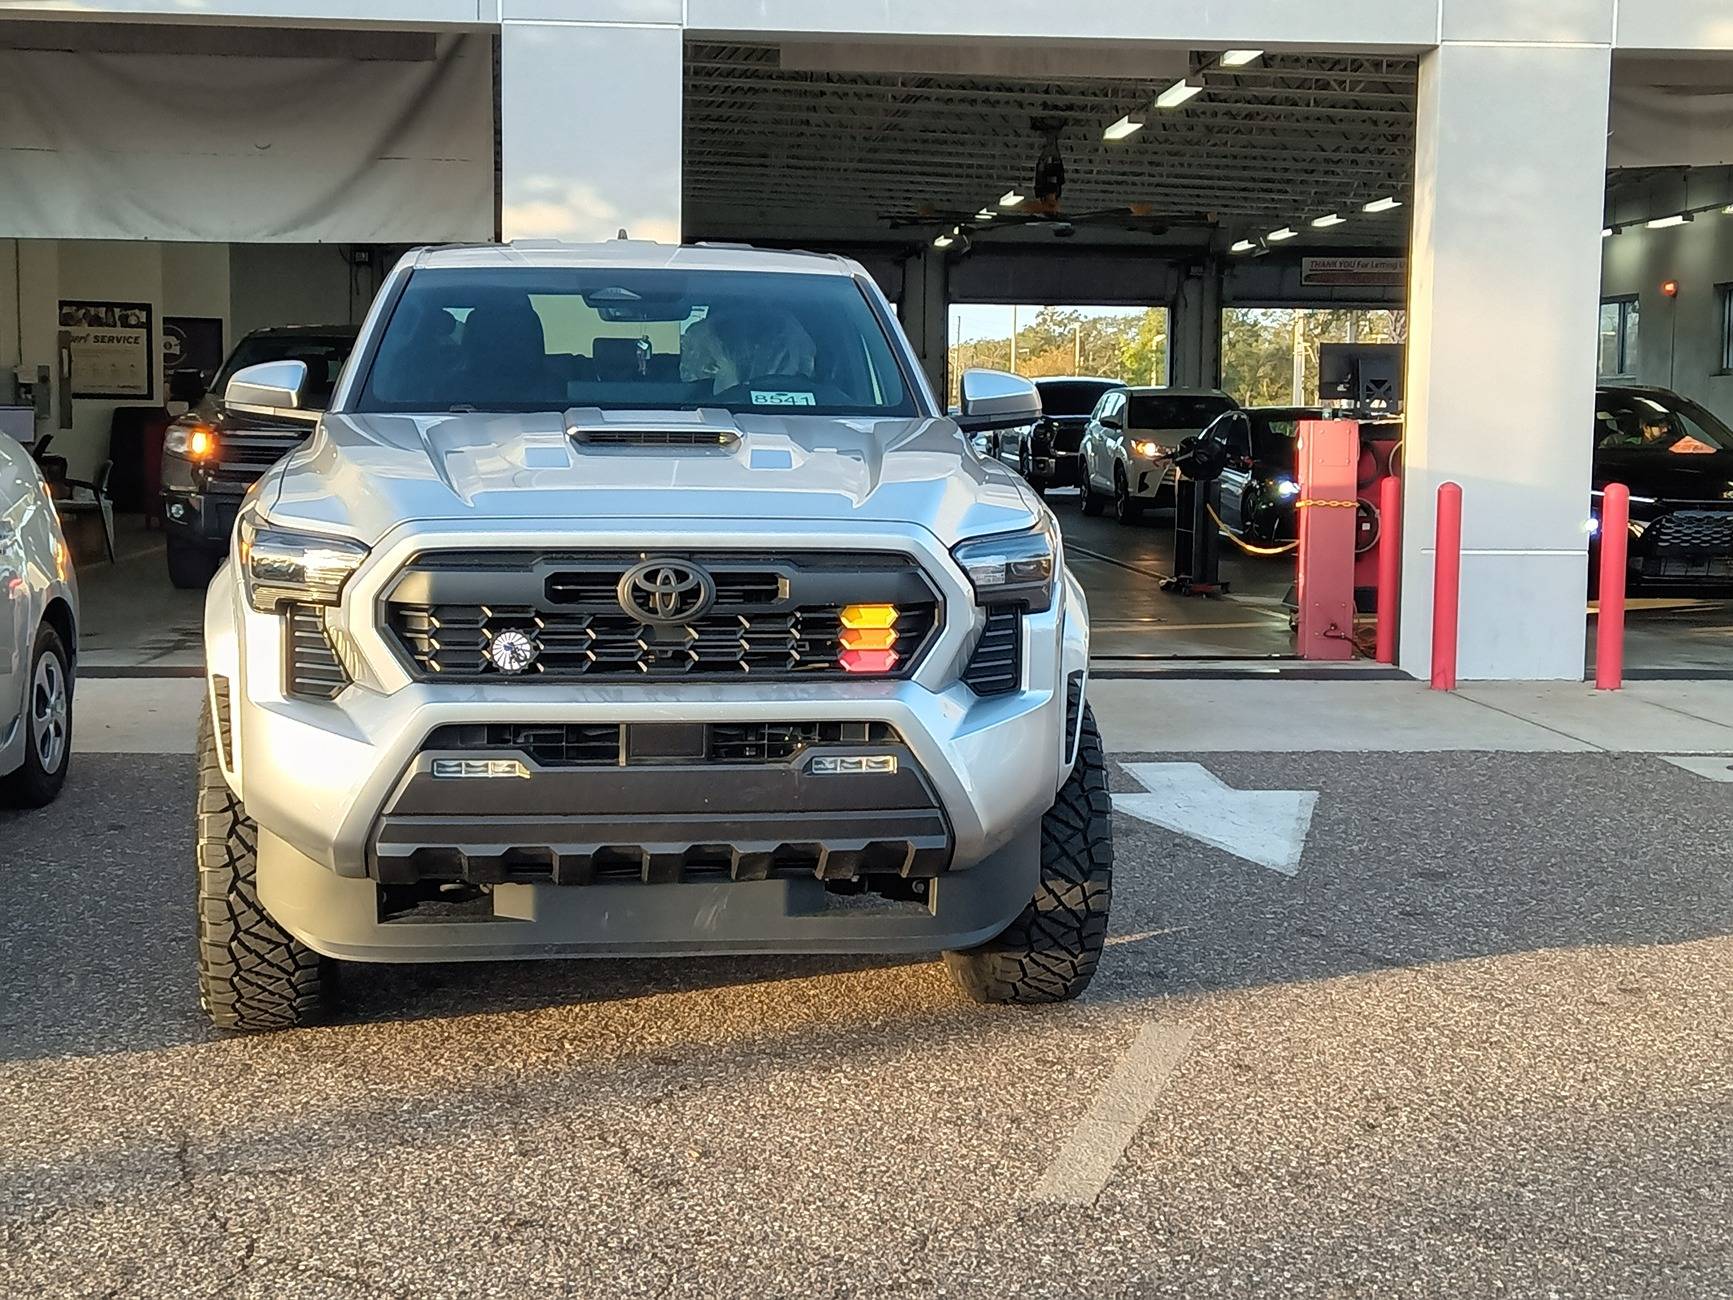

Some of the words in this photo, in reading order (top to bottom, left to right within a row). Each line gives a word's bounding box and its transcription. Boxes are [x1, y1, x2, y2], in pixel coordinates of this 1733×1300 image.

[1310, 260, 1337, 269] THANK
[1338, 260, 1356, 269] YOU
[93, 335, 141, 344] SERVICE
[754, 395, 810, 405] 8541
